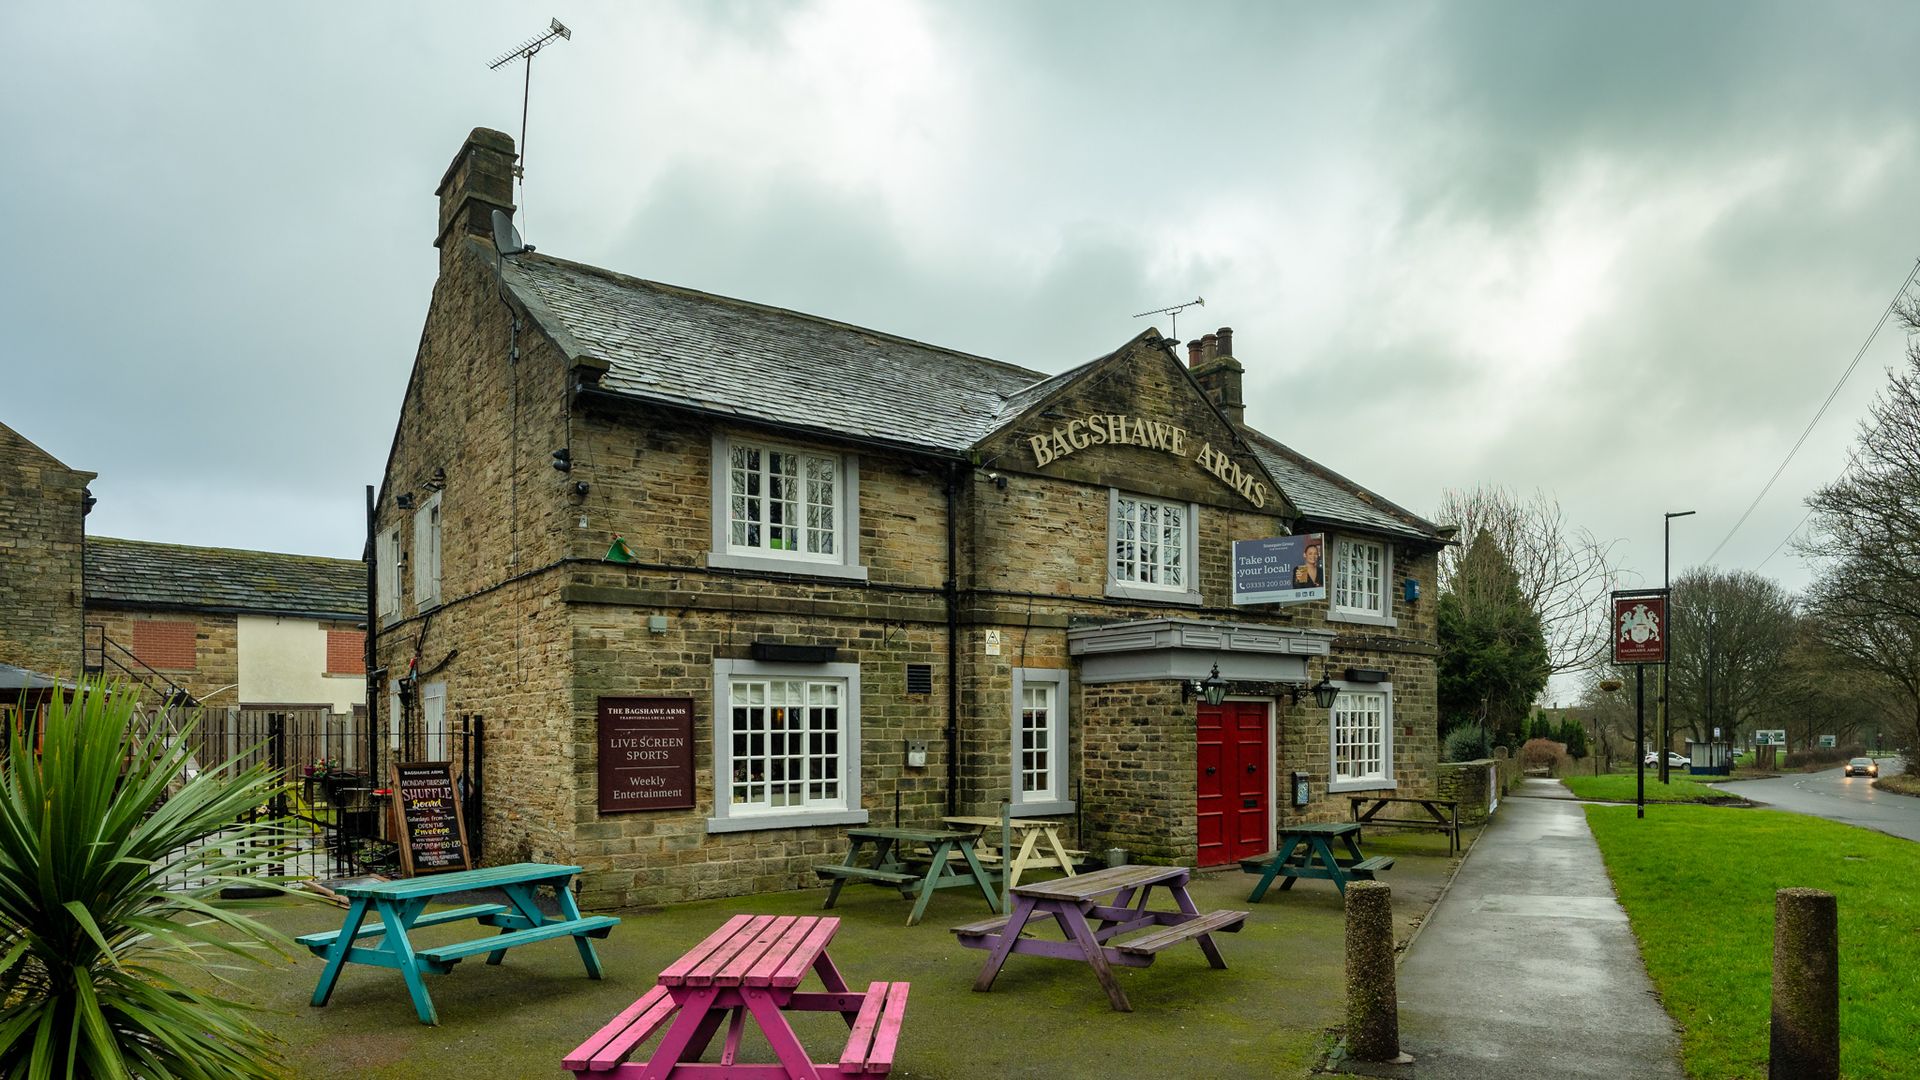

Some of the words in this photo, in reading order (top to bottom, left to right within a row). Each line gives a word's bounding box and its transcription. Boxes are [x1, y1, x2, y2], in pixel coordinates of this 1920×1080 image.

[1027, 414, 1187, 468] BAGSHAWE
[1195, 441, 1268, 508] ARMS
[1239, 555, 1262, 566] Take
[1264, 555, 1277, 563] on
[1239, 567, 1262, 577] your
[1264, 564, 1291, 574] local!
[611, 739, 638, 748] LIVE
[640, 738, 684, 748] SCREEN
[627, 750, 669, 760] SPORTS
[630, 776, 666, 787] Weekly
[402, 787, 452, 801] SHUFFLE
[613, 789, 682, 799] Entertainment
[412, 799, 443, 809] Board
[415, 828, 450, 836] Envelope
